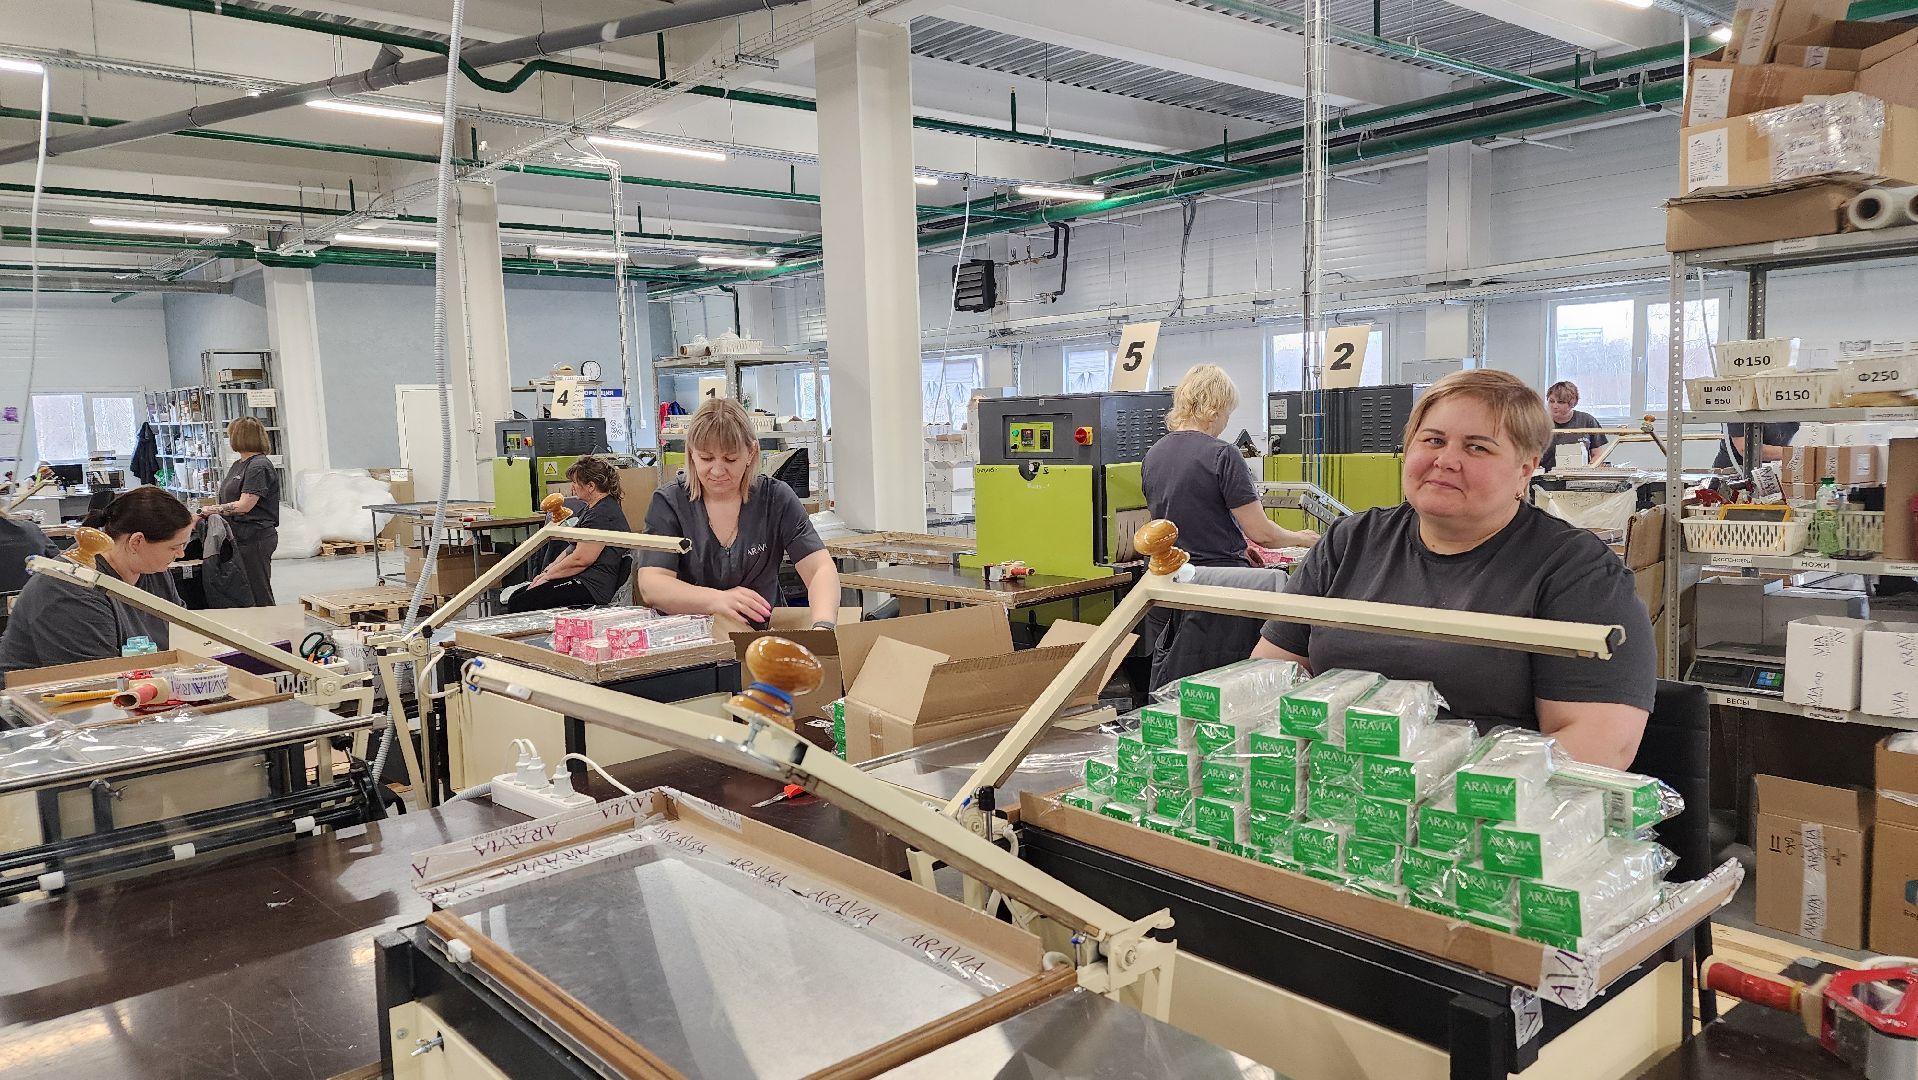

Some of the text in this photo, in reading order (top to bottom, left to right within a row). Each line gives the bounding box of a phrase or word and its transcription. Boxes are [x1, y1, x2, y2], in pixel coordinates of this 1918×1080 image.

[1122, 340, 1145, 371] 5
[1329, 342, 1355, 370] 2
[1733, 355, 1771, 367] Ф150
[1858, 370, 1899, 383] Ф250
[556, 389, 568, 407] 4
[1775, 389, 1810, 401] Б150
[1801, 560, 1830, 569] НОЖИ
[1183, 688, 1216, 701] ARAVIA
[1726, 697, 1750, 706] ВЕСЫ
[1351, 720, 1393, 733] ARAVIA
[1256, 741, 1291, 755] ARAVIA
[1156, 755, 1184, 767] ARAIA
[1200, 806, 1230, 821] ARAIA
[472, 822, 559, 858] ARAVIA
[1298, 832, 1335, 850] ARAIA
[1409, 856, 1447, 874] ARAIA
[1467, 875, 1505, 893] ARAIA
[1526, 890, 1573, 909] ARAVIA
[805, 890, 880, 926] ARAVIA
[902, 933, 986, 975] ARAVIA
